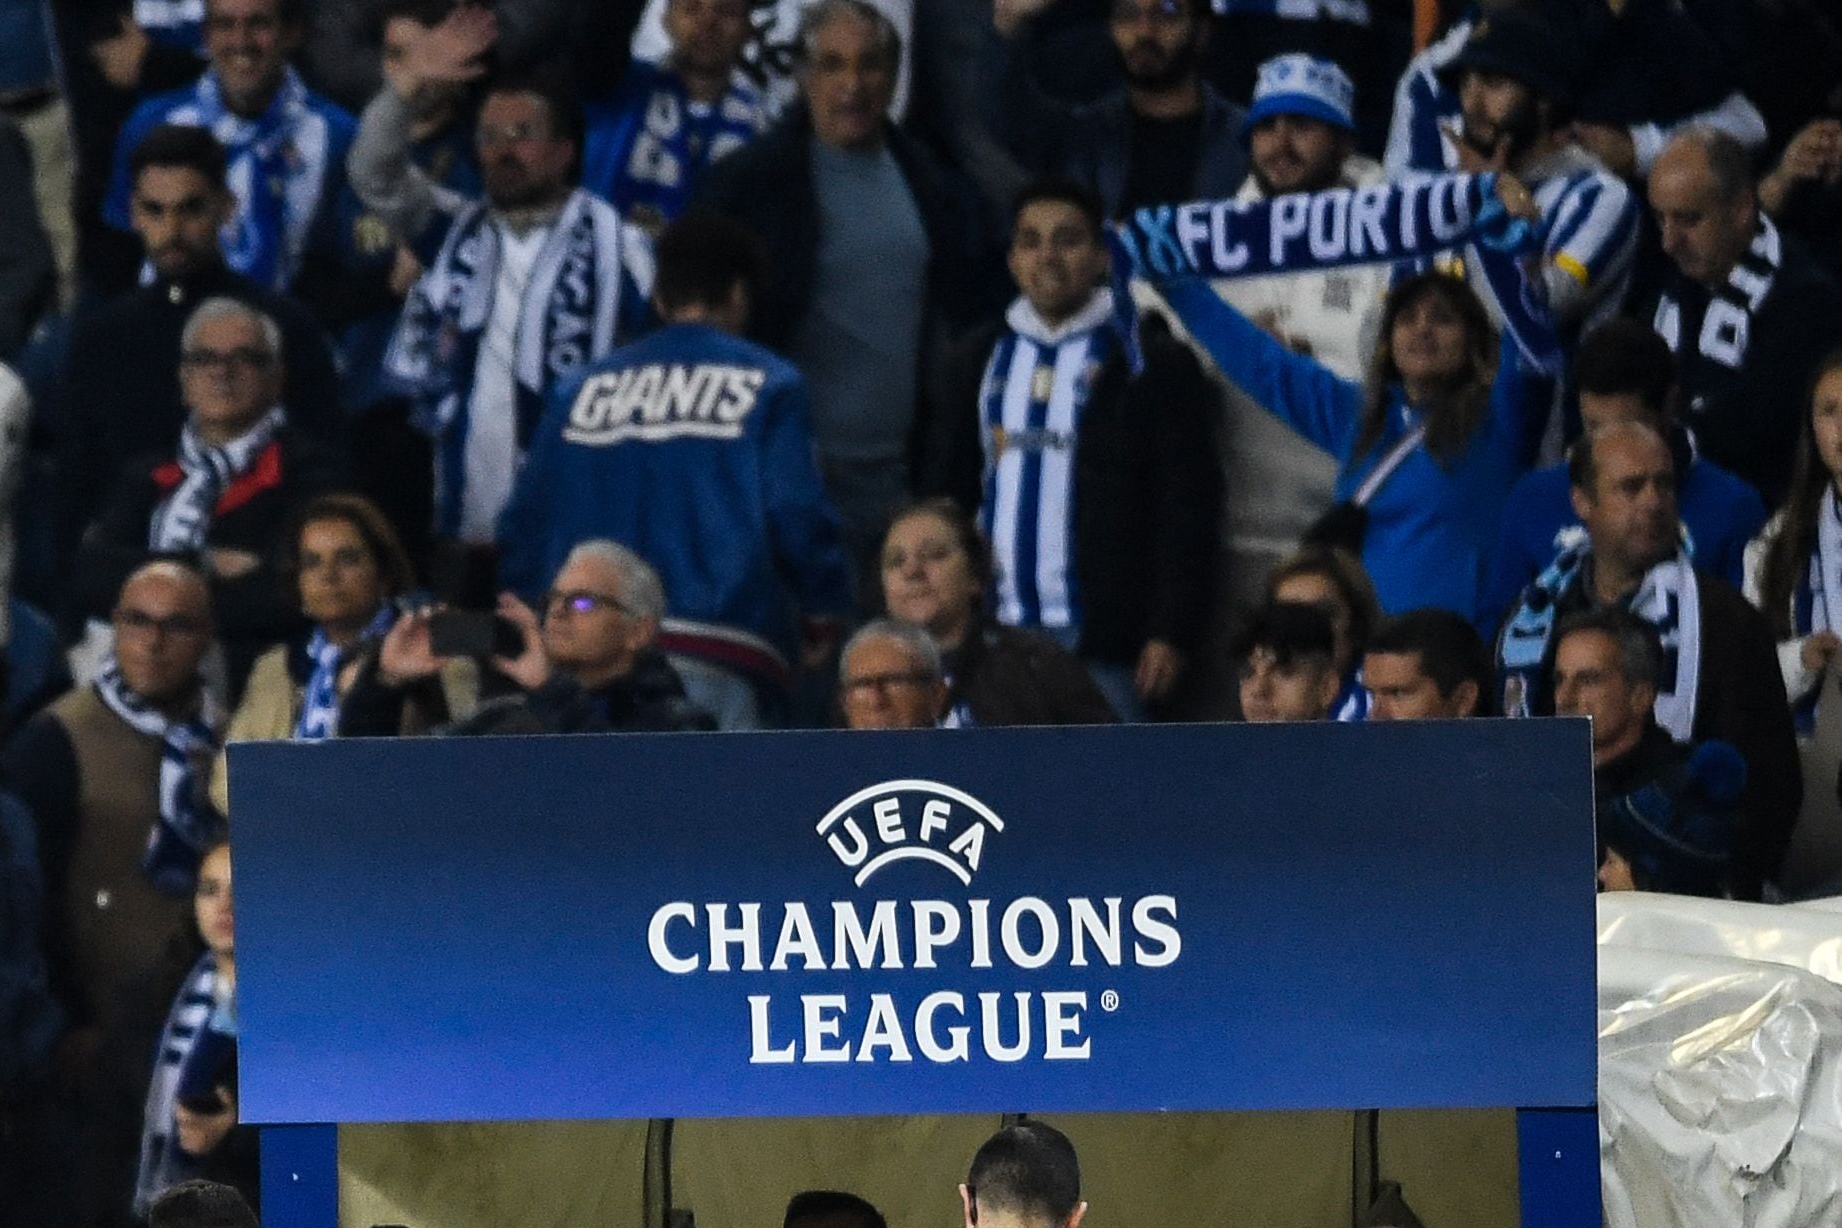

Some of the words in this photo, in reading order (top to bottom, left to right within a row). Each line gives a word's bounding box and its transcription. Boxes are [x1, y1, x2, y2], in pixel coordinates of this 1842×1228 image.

[1176, 200, 1250, 273] FC
[1268, 172, 1475, 267] PORTO
[568, 362, 766, 430] GIANTS
[826, 796, 986, 872] UEFA
[647, 894, 1182, 974] CHAMPIONS
